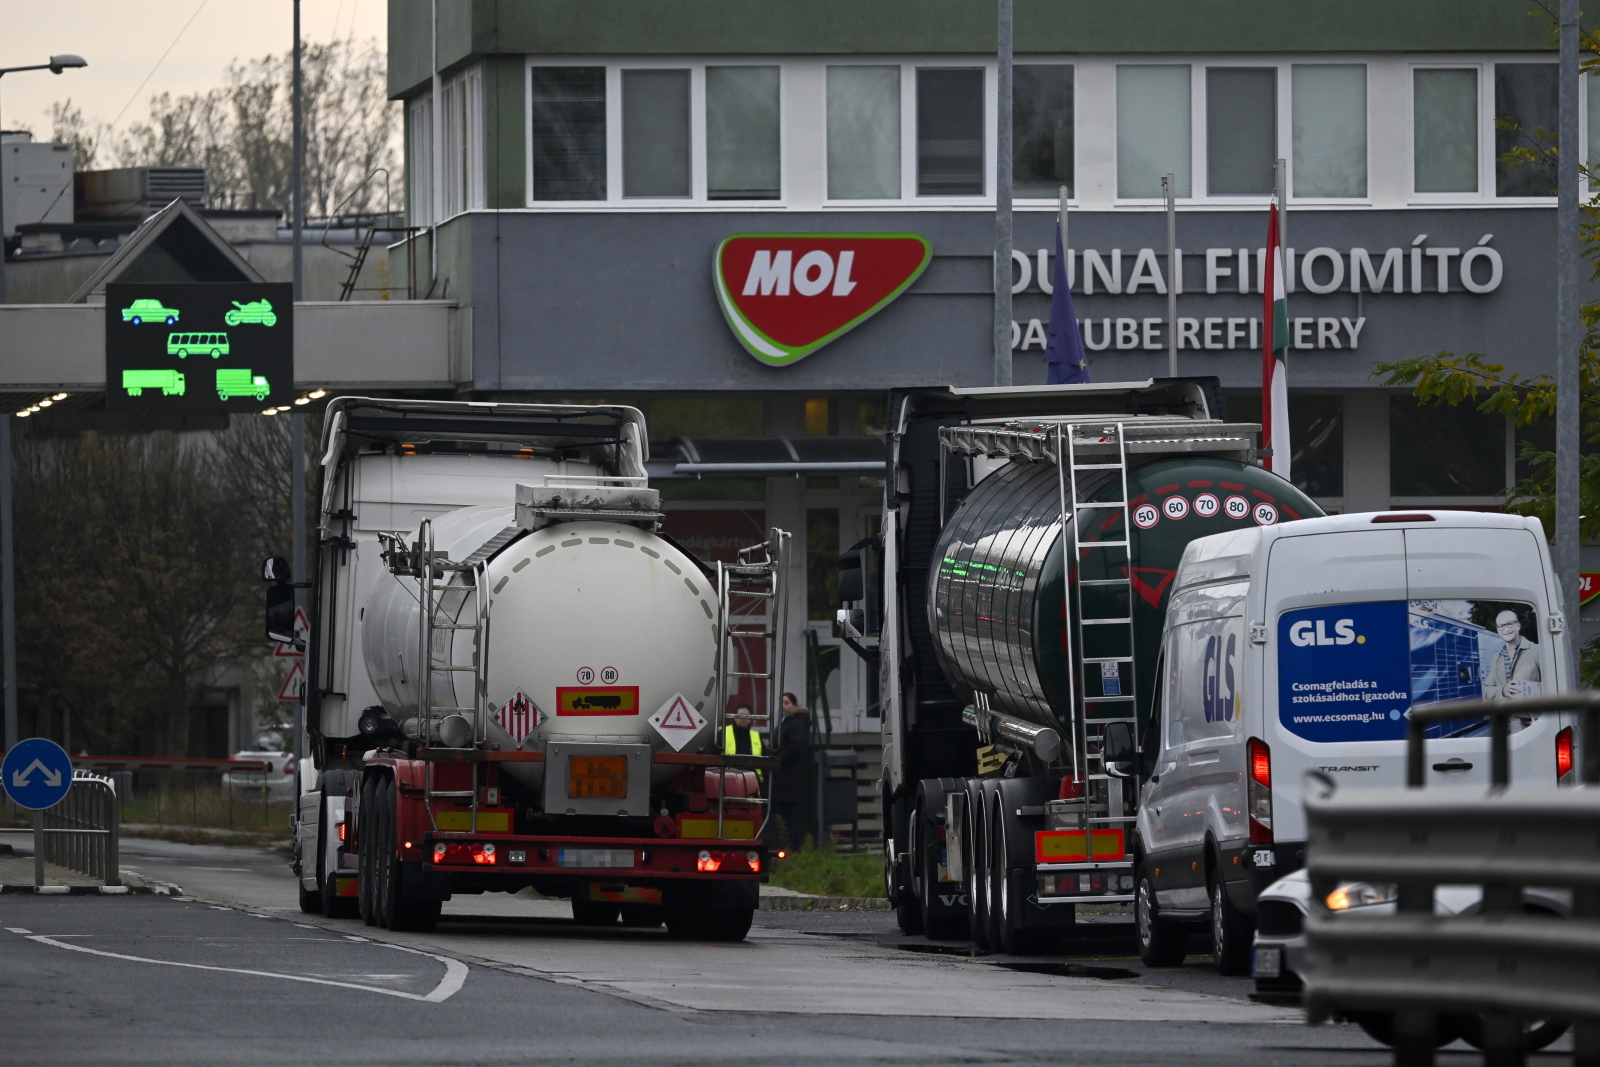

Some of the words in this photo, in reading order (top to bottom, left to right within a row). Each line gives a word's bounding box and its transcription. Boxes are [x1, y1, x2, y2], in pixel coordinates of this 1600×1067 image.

[741, 249, 858, 297] MOL
[1011, 317, 1163, 351] AUBE
[1176, 317, 1367, 350] REFIERY
[1138, 510, 1155, 523] 50
[1168, 502, 1183, 513] 60
[1198, 500, 1214, 510] 70
[1229, 501, 1244, 513] 80
[1258, 508, 1273, 521] 90
[580, 671, 591, 680] 70
[604, 670, 615, 680] 80
[1292, 679, 1369, 692] Csomagfeladás
[1292, 692, 1360, 704] szokásaidhoz
[1361, 690, 1407, 703] igazodva
[1293, 711, 1385, 723] www.ecsomag.hu
